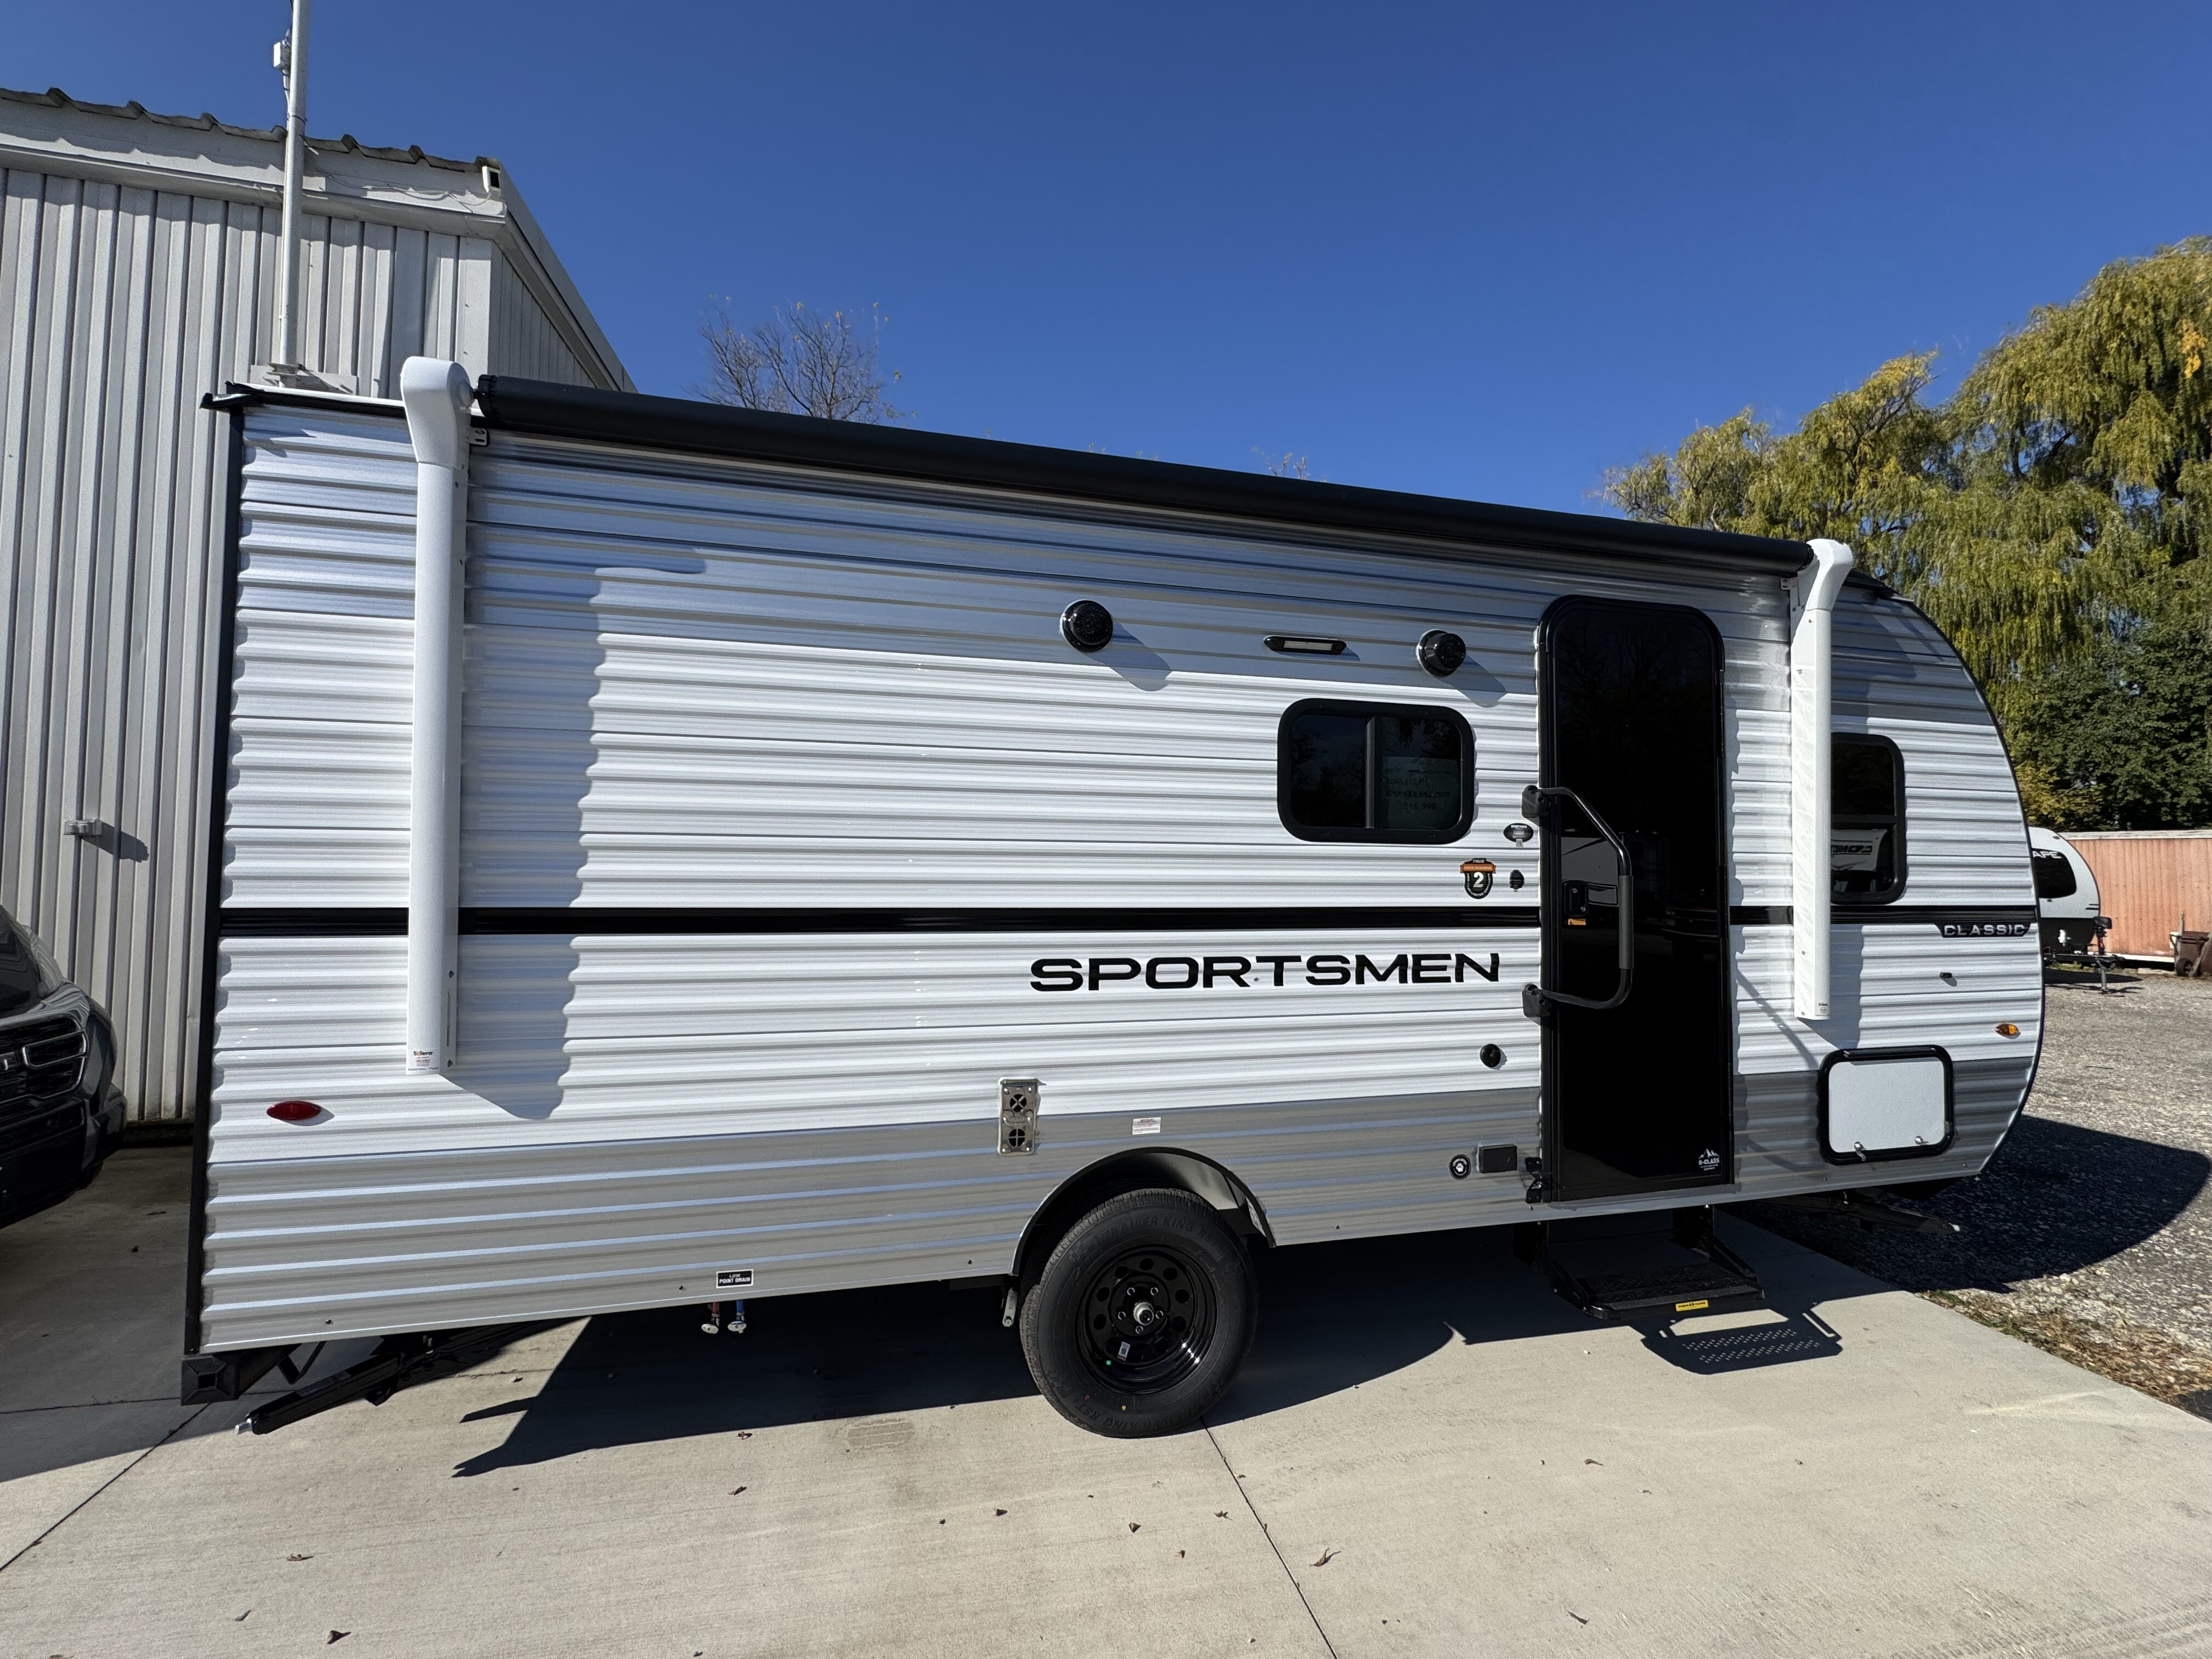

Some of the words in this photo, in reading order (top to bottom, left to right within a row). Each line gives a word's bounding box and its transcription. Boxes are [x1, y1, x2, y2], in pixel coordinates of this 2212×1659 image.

[1472, 872, 1484, 888] 2
[1944, 924, 2025, 936] CLASSIC
[1030, 952, 1500, 991] SPORTSMEN
[1163, 1215, 1195, 1232] KING
